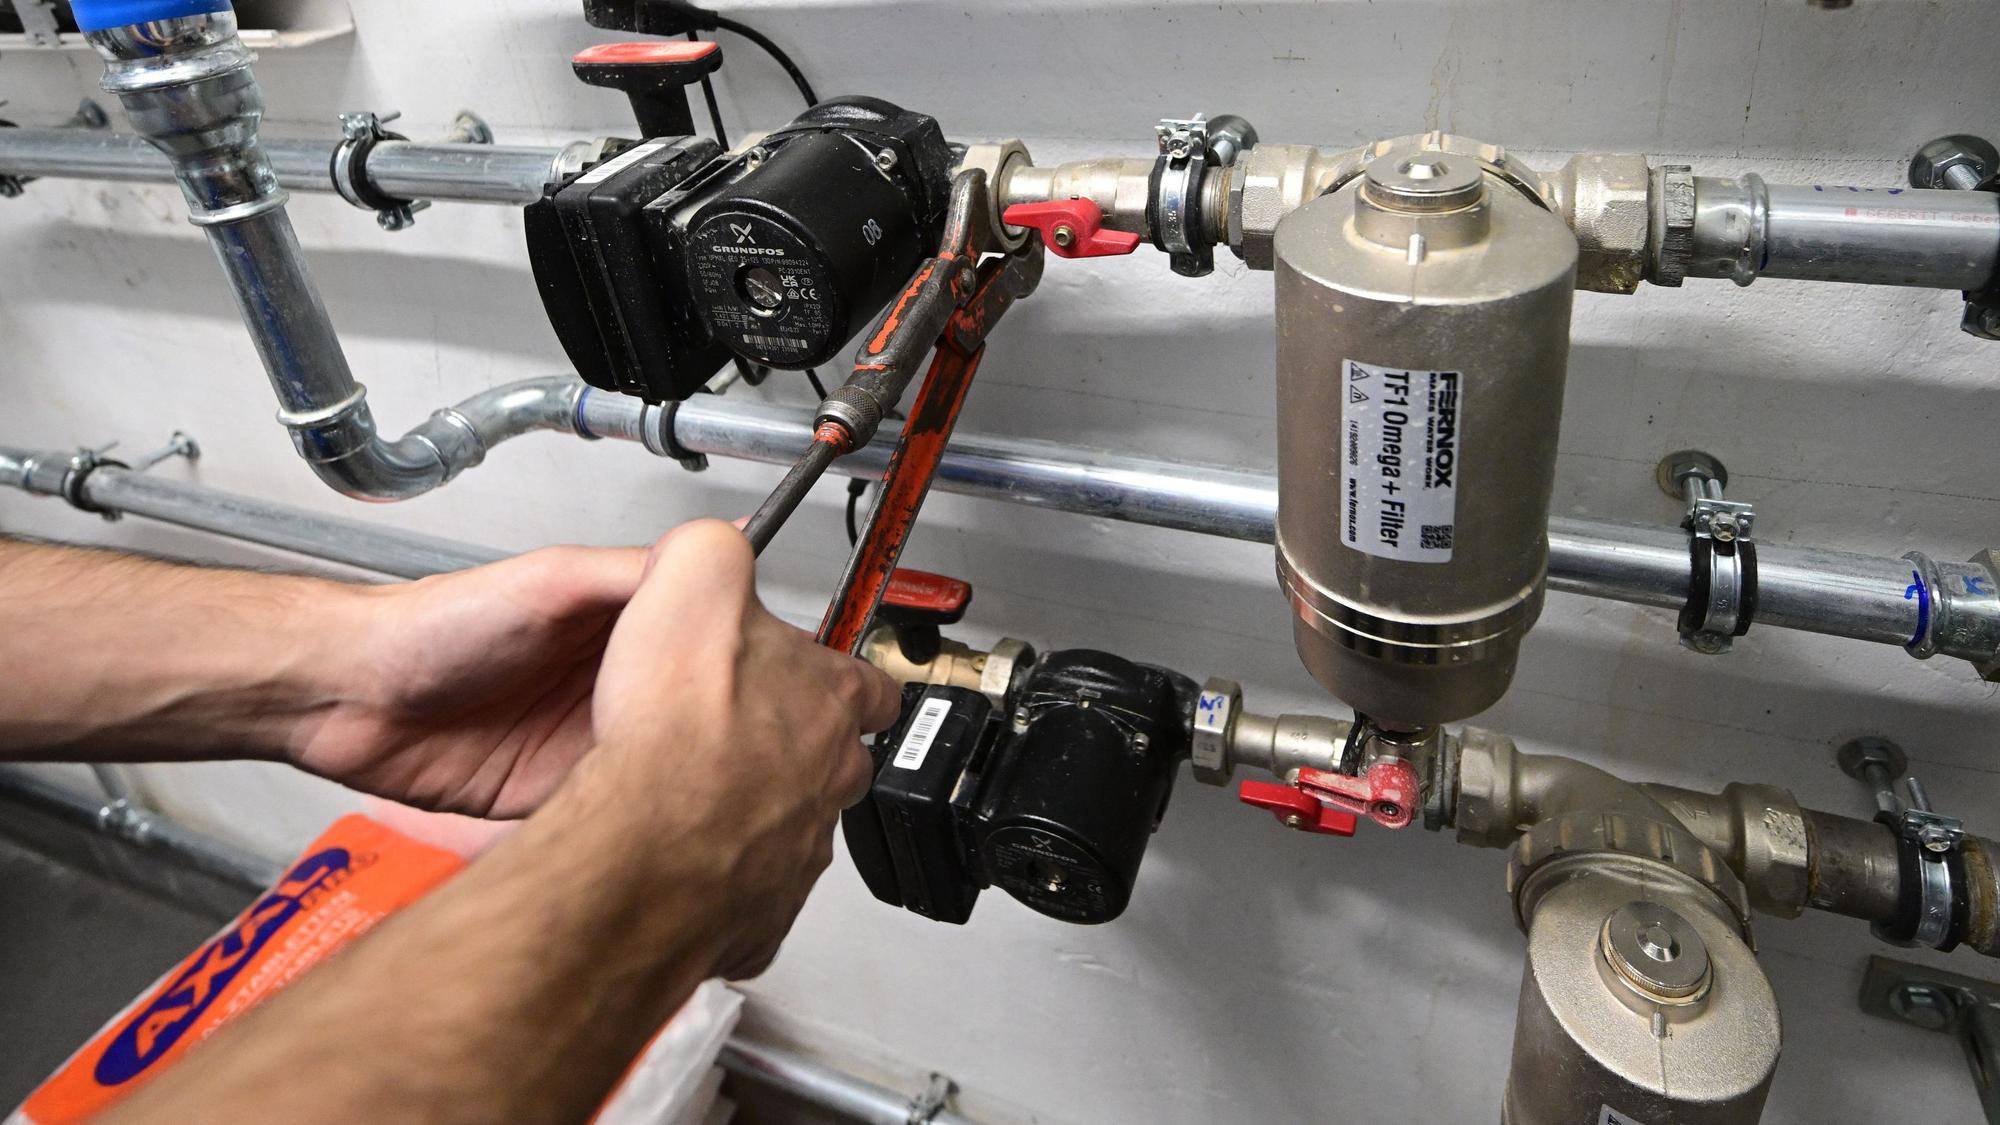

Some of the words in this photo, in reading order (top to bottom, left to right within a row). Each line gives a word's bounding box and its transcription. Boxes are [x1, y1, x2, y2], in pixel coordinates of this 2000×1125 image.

[712, 245, 785, 256] GRUNDFOS
[862, 218, 882, 246] 08
[800, 288, 818, 300] CE
[1384, 372, 1409, 407] TF1
[1428, 372, 1437, 412] MAKES
[1377, 410, 1409, 477] Omega
[1426, 416, 1435, 453] WATER
[1434, 372, 1458, 489] FERNOX
[1387, 480, 1400, 495] +
[1349, 478, 1358, 543] www.fernox.com
[1381, 499, 1405, 548] Filter
[136, 865, 331, 1059] AXAL
